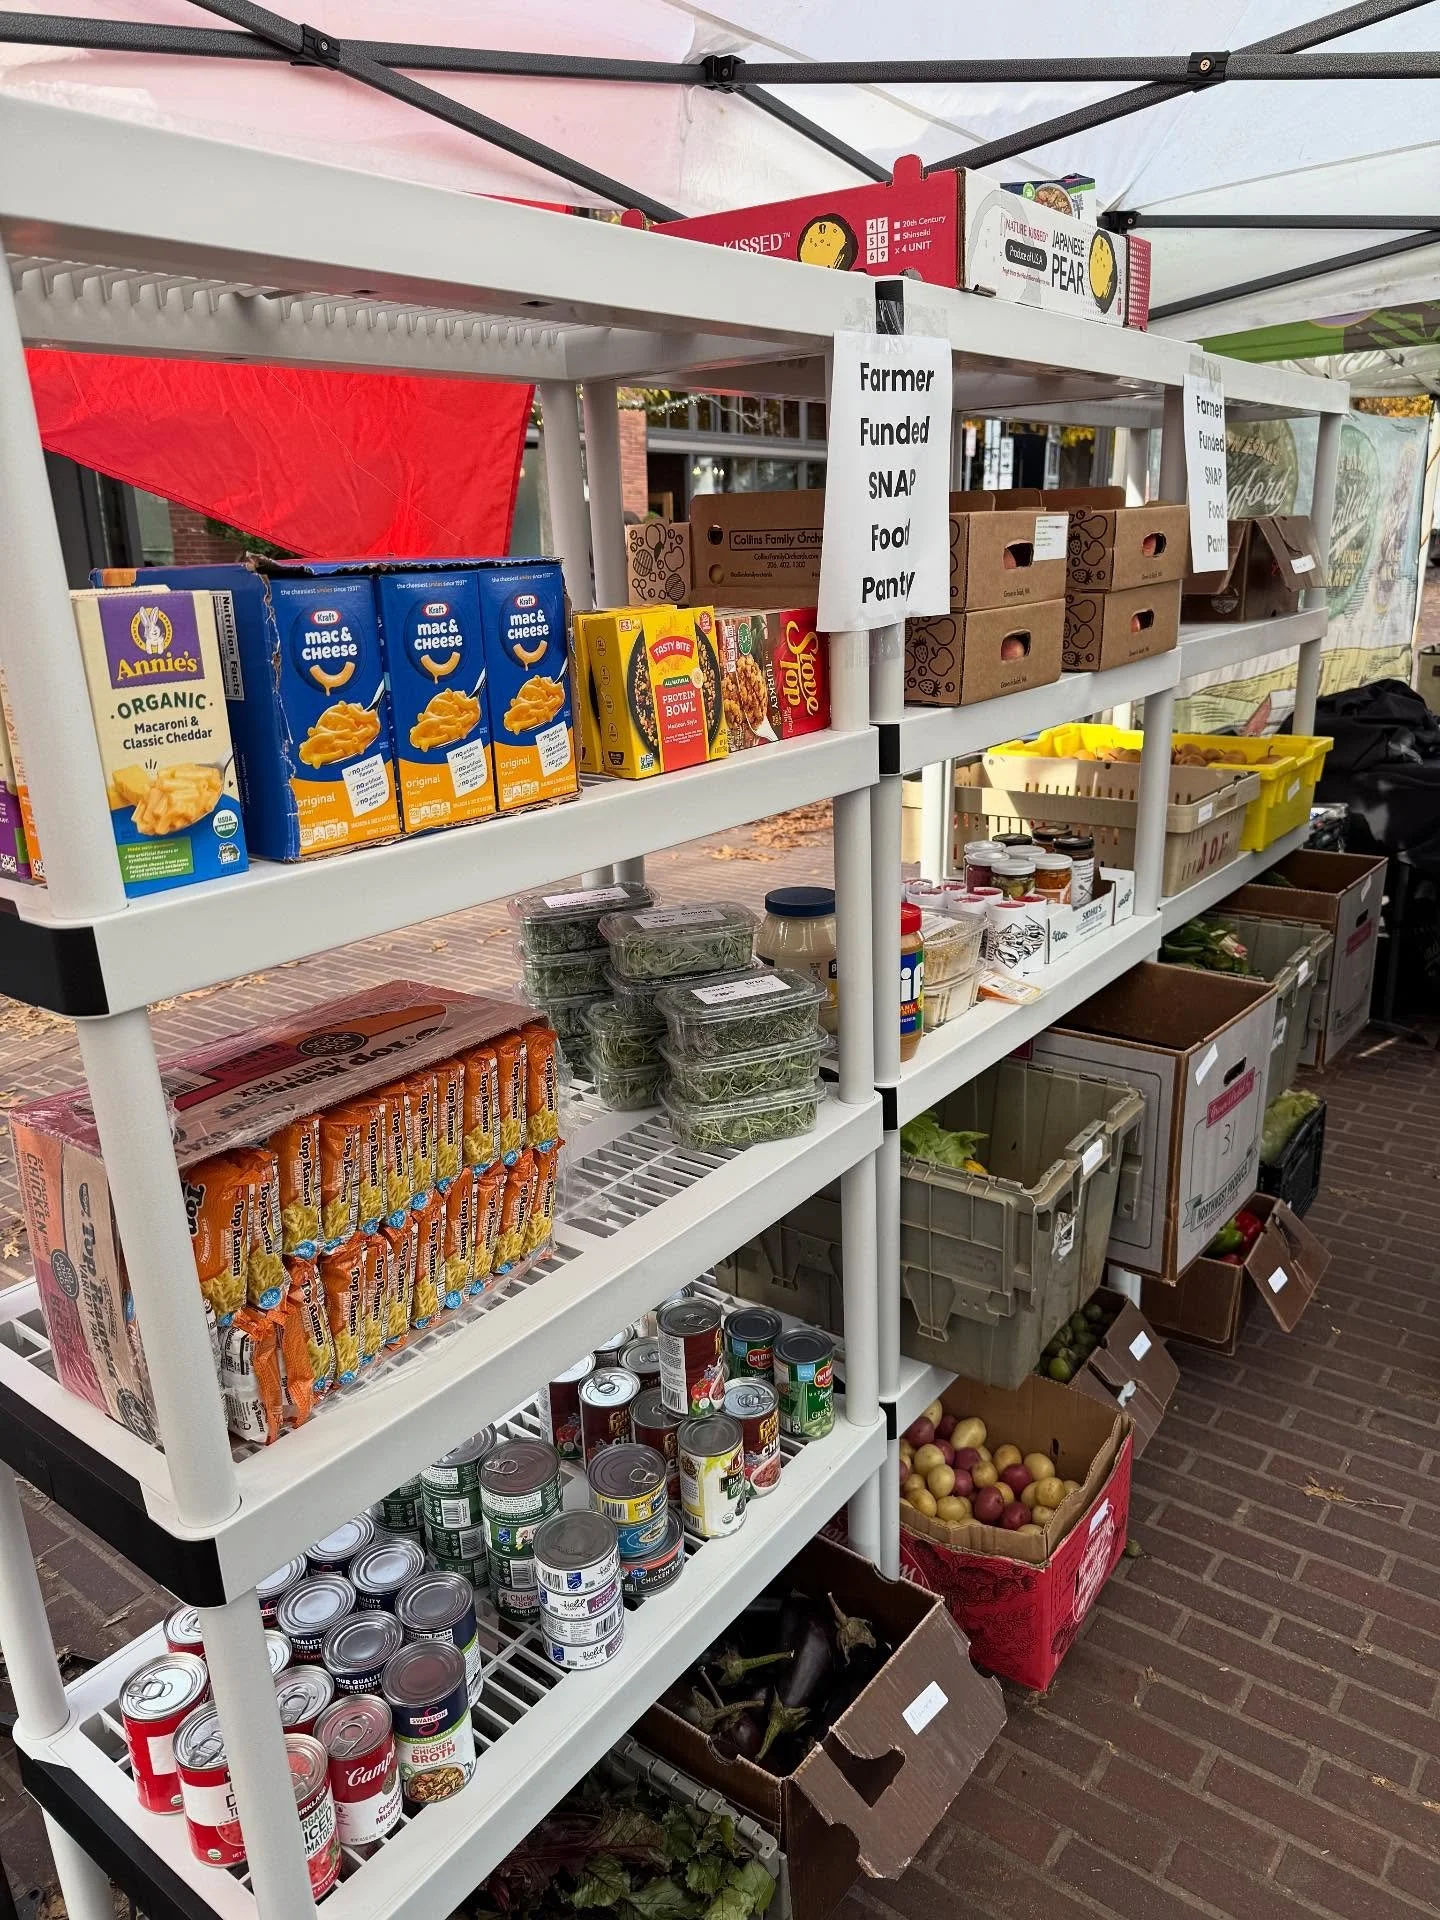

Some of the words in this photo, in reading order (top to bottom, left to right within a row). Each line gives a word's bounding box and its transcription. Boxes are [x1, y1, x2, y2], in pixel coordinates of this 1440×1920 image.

[869, 222, 875, 231] 4
[880, 221, 886, 229] 7
[902, 219, 917, 228] 20th
[918, 215, 947, 226] Century
[1005, 218, 1027, 236] NATURE
[869, 238, 875, 246] 5
[901, 243, 908, 253] 4
[908, 240, 932, 252] UNIT
[1009, 245, 1027, 261] Produce
[1052, 230, 1085, 257] JAPANESE
[869, 252, 875, 261] 6
[880, 251, 886, 259] 9
[1051, 253, 1085, 296] PEAR
[860, 362, 935, 392] Farmer
[1196, 395, 1223, 419] Farmer
[860, 415, 931, 446] Funded
[1199, 431, 1225, 452] Funded
[868, 468, 916, 500] SNAP
[1204, 465, 1222, 486] SNAP
[734, 534, 763, 546] Collins
[765, 533, 795, 547] Family
[871, 518, 911, 551] Food
[861, 570, 916, 603] Panty
[428, 605, 445, 615] Kraft
[519, 596, 534, 606] Kraft
[317, 612, 336, 622] Kraft
[417, 621, 448, 636] mac
[448, 618, 459, 633] &
[510, 612, 535, 626] mac
[536, 609, 546, 623] &
[222, 596, 236, 656] Nutrition
[229, 660, 241, 696] Facts
[305, 630, 340, 645] mac
[340, 627, 353, 642] &
[653, 641, 675, 657] TASTY
[675, 640, 692, 653] BITE
[117, 650, 199, 681] Annie's
[785, 620, 819, 716] Stove
[765, 660, 779, 709] TURKEY
[780, 659, 801, 706] Top
[117, 691, 207, 720] ORGANIC
[662, 690, 696, 704] PROTEIN
[665, 701, 697, 718] BOWL
[134, 716, 188, 735] Macaroni
[190, 715, 199, 727] &
[123, 733, 164, 750] Classic
[166, 728, 213, 745] Cheddar
[352, 767, 361, 775] no
[500, 755, 531, 770] original
[356, 782, 365, 790] no
[406, 774, 441, 789] original
[297, 791, 336, 808] original
[360, 797, 369, 805] no
[217, 815, 233, 824] USDA
[900, 961, 924, 1002] if
[280, 1057, 342, 1083] VARIETY
[511, 1059, 520, 1081] Top
[543, 1054, 554, 1076] Top
[233, 1077, 277, 1098] PACK
[445, 1080, 457, 1103] Top
[479, 1072, 489, 1095] Top
[545, 1075, 555, 1112] Ramen
[418, 1092, 430, 1116] Top
[512, 1079, 520, 1120] Ramen
[391, 1110, 401, 1134] Top
[447, 1103, 455, 1146] Ramen
[481, 1094, 489, 1134] Ramen
[367, 1119, 379, 1143] Top
[419, 1115, 430, 1159] Ramen
[298, 1133, 311, 1160] Top
[342, 1136, 353, 1158] Top
[394, 1133, 404, 1177] Ramen
[370, 1142, 380, 1188] Ramen
[26, 1152, 48, 1235] CHICKEN
[301, 1158, 313, 1207] Ramen
[40, 1175, 50, 1218] PACKS
[258, 1183, 270, 1211] Top
[459, 1197, 469, 1220] Top
[231, 1200, 245, 1228] Top
[260, 1207, 274, 1255] Ramen
[428, 1219, 439, 1242] Top
[460, 1219, 469, 1260] Ramen
[82, 1222, 97, 1277] Top
[232, 1227, 243, 1278] Ramen
[399, 1239, 409, 1260] Top
[57, 1255, 72, 1292] ADDED
[374, 1256, 385, 1280] Top
[429, 1241, 438, 1284] Ramen
[65, 1267, 74, 1284] NO
[348, 1266, 361, 1294] Top
[397, 1259, 408, 1303] Ramen
[78, 1263, 95, 1322] VARIETY
[88, 1321, 104, 1354] PACK
[350, 1293, 361, 1337] Ramen
[89, 1277, 119, 1380] Ramen
[308, 1303, 325, 1347] Ramen
[641, 1571, 670, 1585] CHICKEN
[431, 1629, 452, 1639] Facts
[335, 1677, 351, 1685] OUR
[411, 1710, 447, 1724] SWANSON
[411, 1743, 456, 1764] BROTH
[412, 1740, 453, 1755] CHICKEN
[298, 1786, 327, 1816] IRKLAND
[301, 1799, 329, 1832] RGANIC
